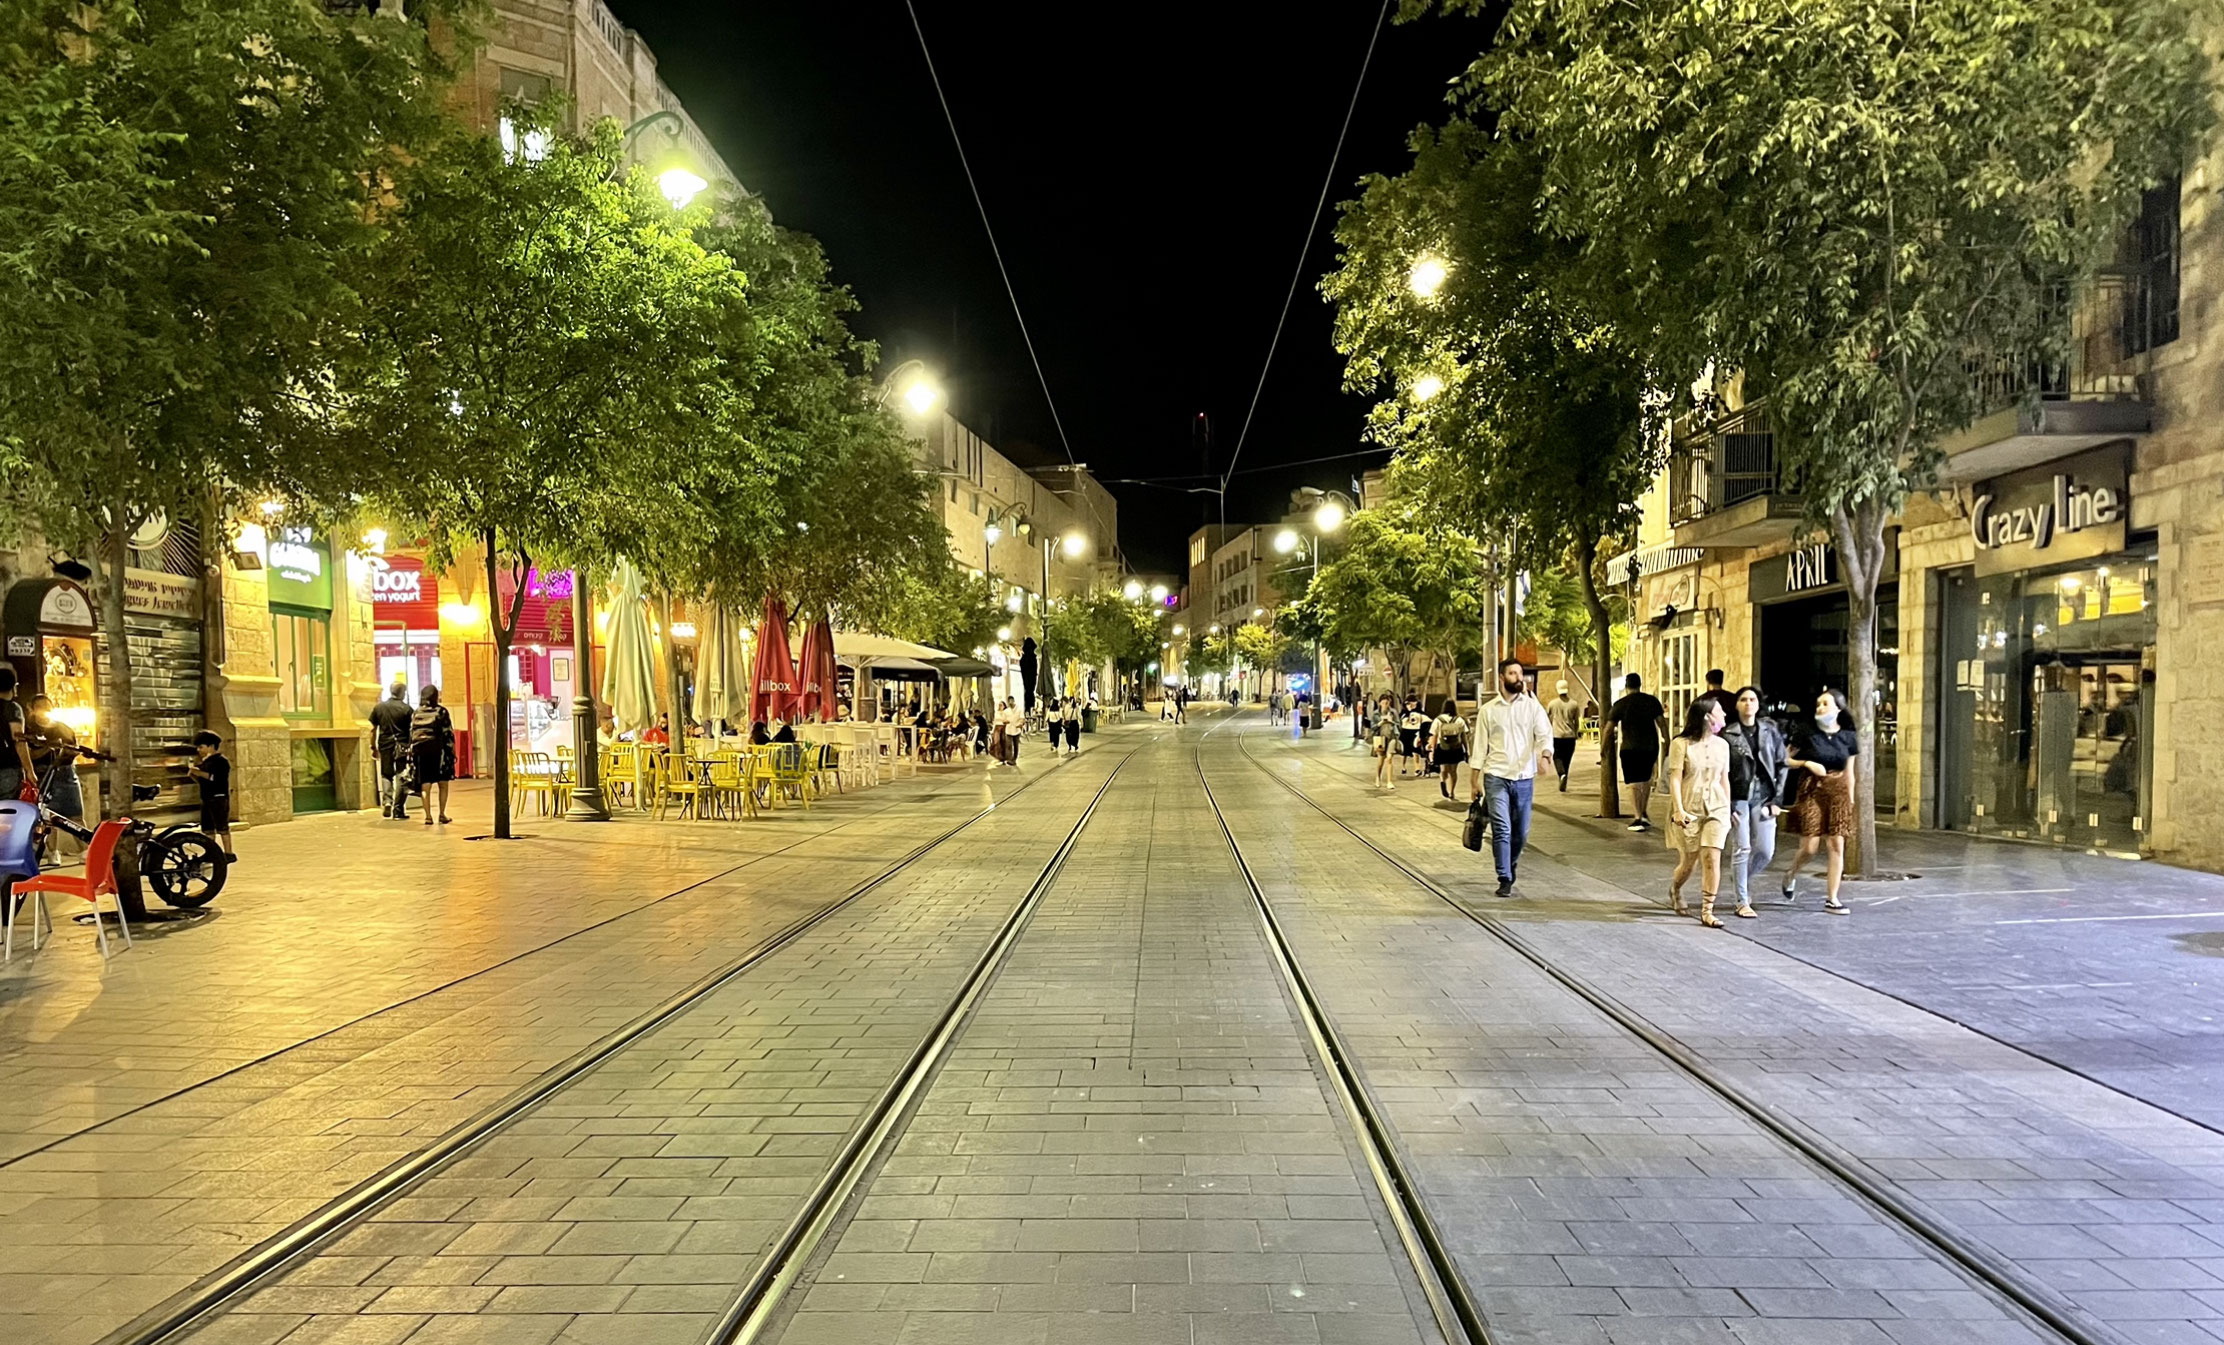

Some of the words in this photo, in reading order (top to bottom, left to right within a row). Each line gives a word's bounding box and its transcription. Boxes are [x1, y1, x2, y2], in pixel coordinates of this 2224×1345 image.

[1971, 494, 2044, 550] Crazy
[2053, 474, 2110, 535] Line
[1785, 543, 1829, 592] APRIL
[760, 679, 791, 692] illbox
